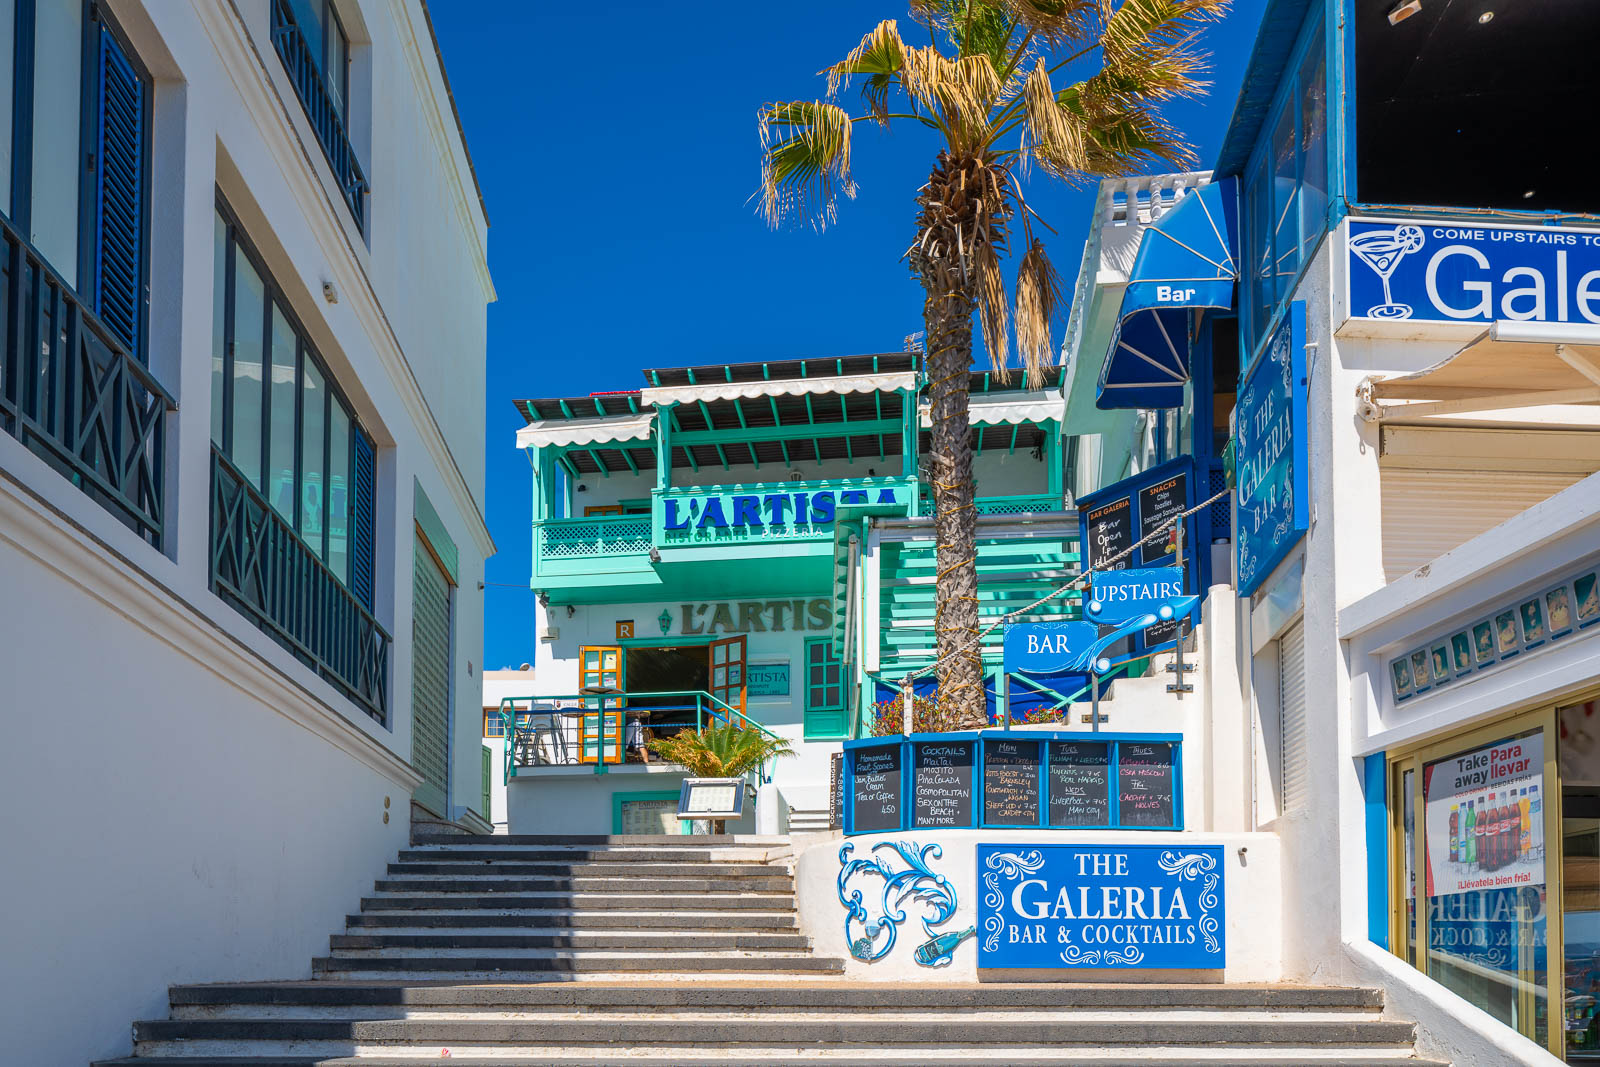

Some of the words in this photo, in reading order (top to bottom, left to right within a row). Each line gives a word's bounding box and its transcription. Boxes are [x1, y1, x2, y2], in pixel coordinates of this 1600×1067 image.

[1432, 228, 1485, 241] COME
[1490, 231, 1577, 246] UPSTAIRS
[1156, 286, 1196, 302] Bar
[1254, 389, 1275, 441] THE
[1238, 405, 1293, 507] GALERIA
[1149, 480, 1177, 496] SNACKS
[1090, 511, 1102, 520] BAR
[1103, 500, 1130, 516] GALERIA
[1162, 503, 1185, 517] Sandwich
[1254, 483, 1277, 535] BAR
[1098, 519, 1121, 533] Bar
[664, 530, 748, 543] RISTORANTE
[761, 527, 824, 539] PIZZERIA
[1097, 531, 1123, 547] Open
[1094, 581, 1182, 603] UPSTAIRS
[620, 625, 630, 637] R
[1027, 634, 1071, 654] BAR
[922, 746, 966, 756] COCKTAILS
[1457, 754, 1489, 773] Take
[1490, 745, 1521, 764] Para
[872, 762, 894, 771] Scones
[1454, 769, 1489, 788] away
[1490, 758, 1531, 779] llevar
[866, 783, 884, 791] Cream
[1077, 775, 1105, 784] MADRID
[1490, 778, 1515, 790] BEBIDAS
[856, 792, 868, 801] Tea
[876, 791, 895, 803] Coffee
[1049, 794, 1084, 805] LIVERPOOL
[1454, 789, 1470, 798] COLD
[917, 798, 933, 807] SEX
[942, 799, 958, 807] THE
[1068, 806, 1085, 815] MAN
[1135, 801, 1160, 809] WOLVES
[930, 807, 954, 816] BEACH
[1073, 853, 1130, 876] THE
[1457, 876, 1494, 890] ¡Llévatela
[1495, 874, 1513, 885] bien
[1514, 871, 1532, 883] fría!
[1011, 879, 1192, 920] GALERIA
[1008, 924, 1048, 944] BAR
[1057, 926, 1072, 944] &
[1082, 924, 1196, 944] COCKTAILS
